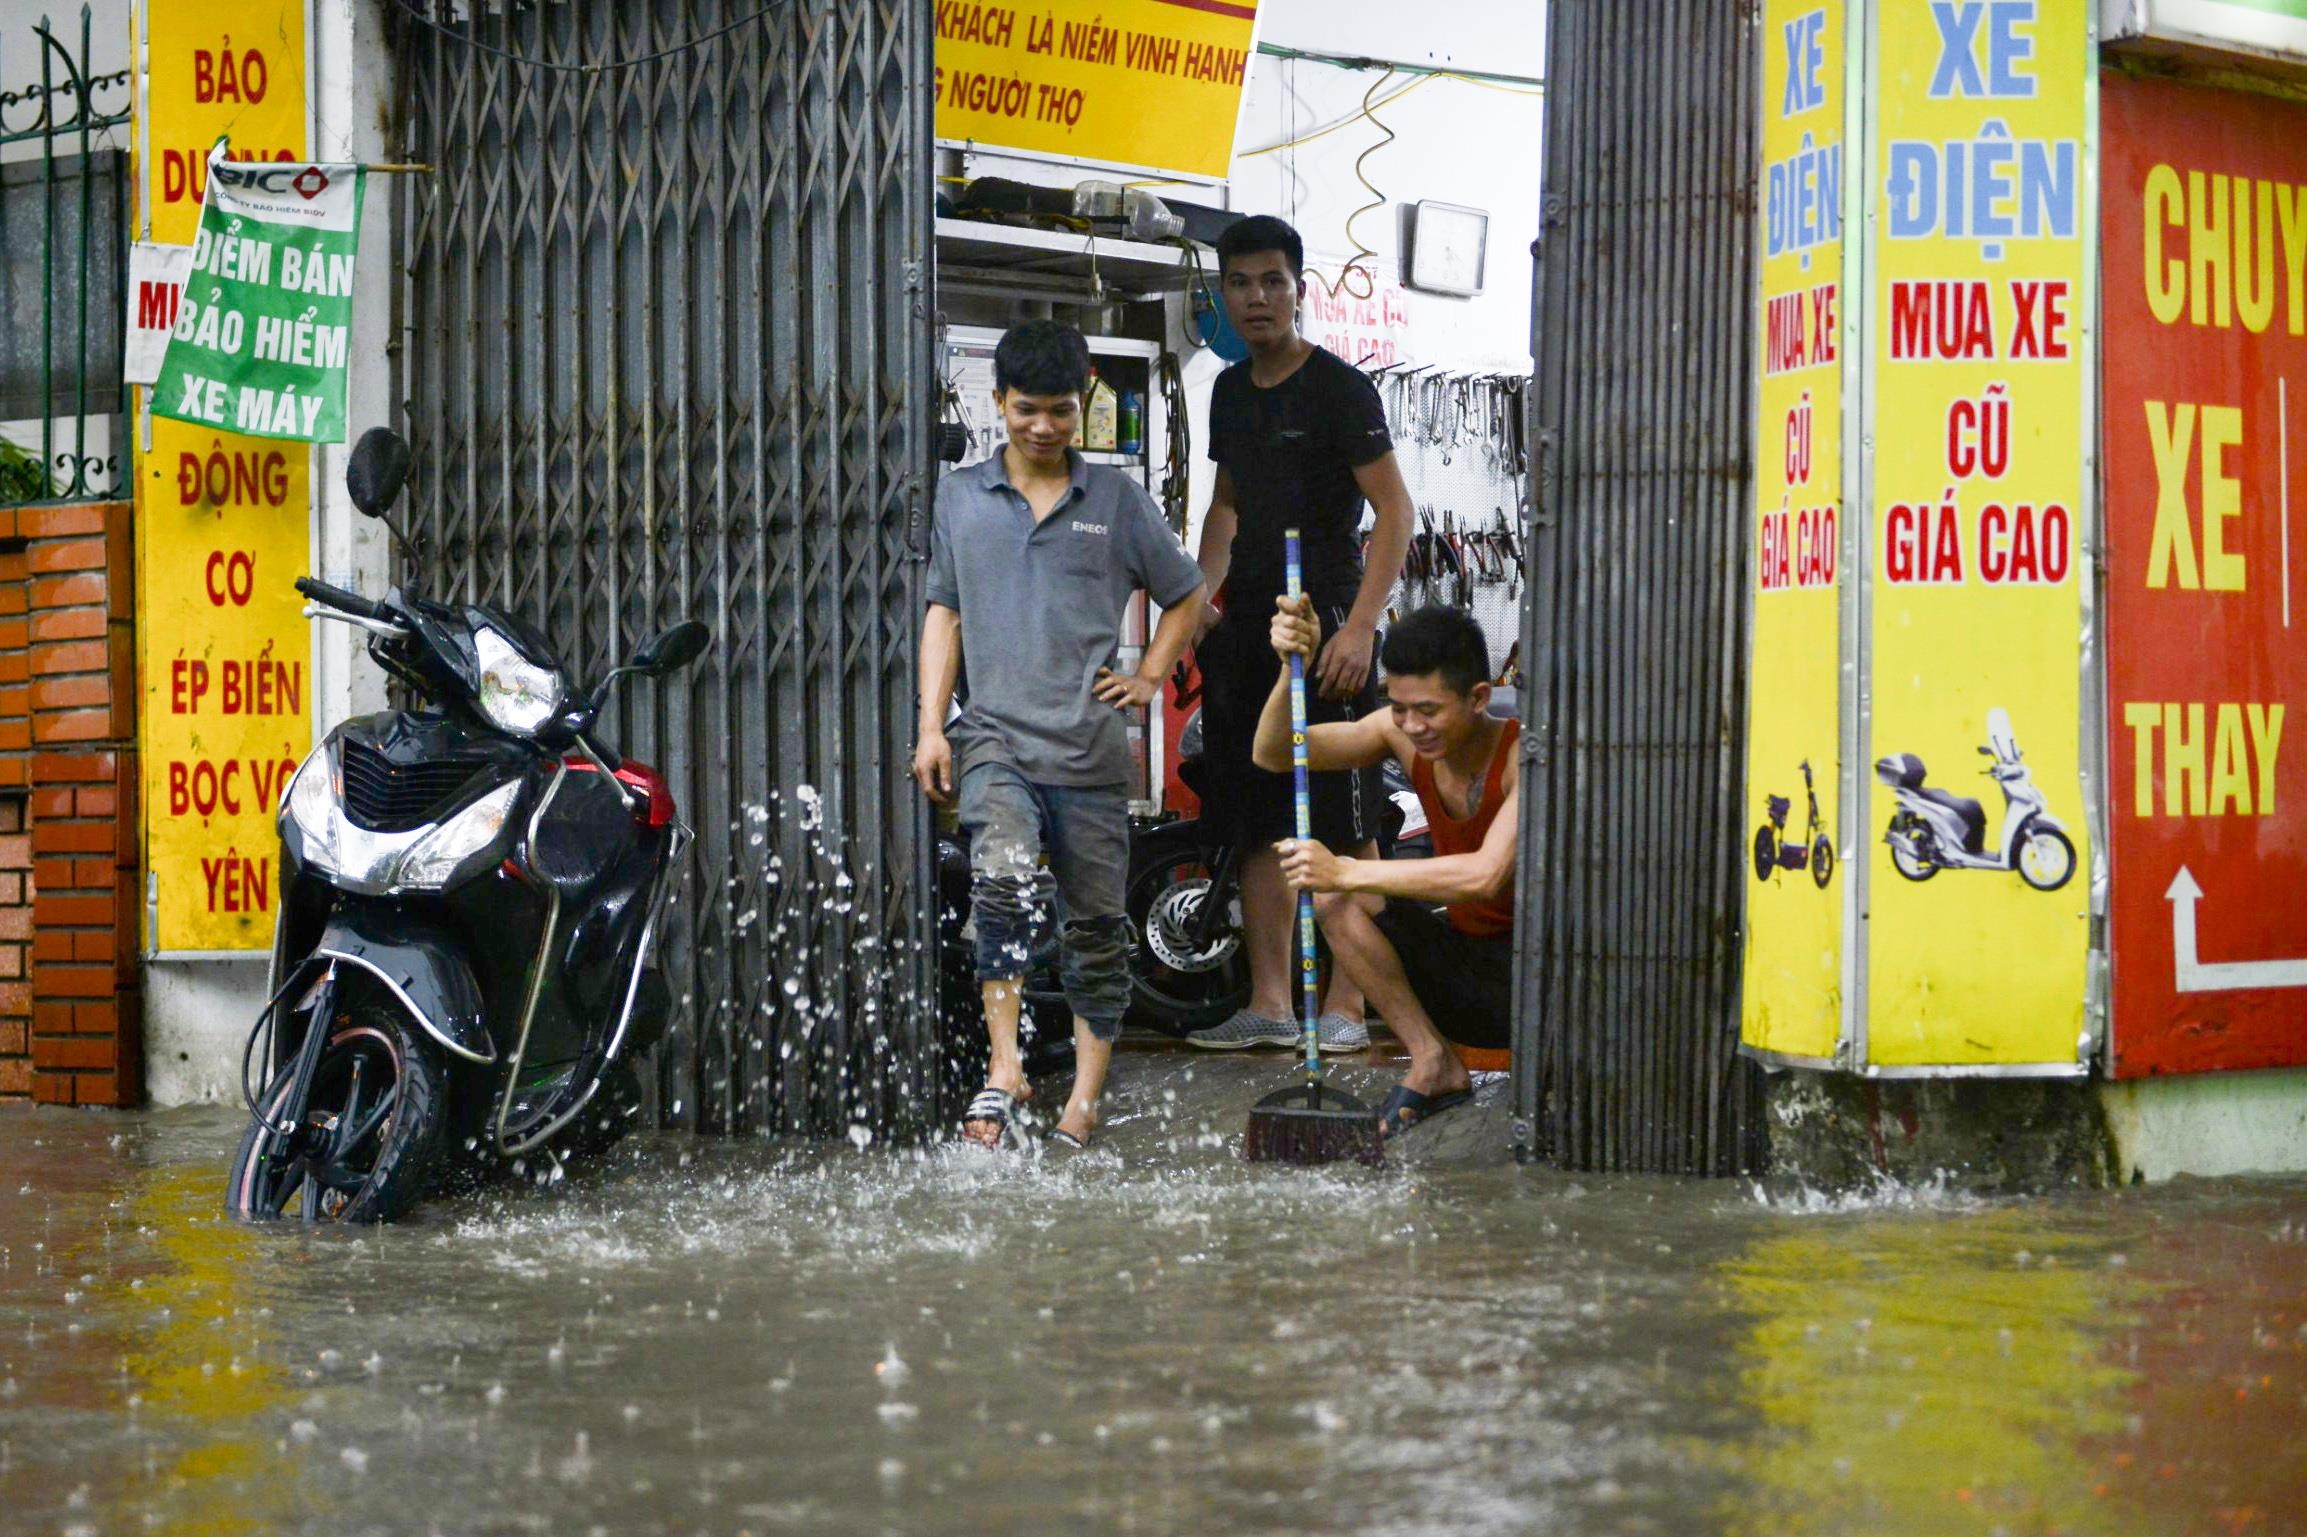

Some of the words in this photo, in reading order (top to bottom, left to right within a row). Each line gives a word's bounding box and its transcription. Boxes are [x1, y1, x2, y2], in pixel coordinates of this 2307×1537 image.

[194, 35, 267, 105] BẢO
[1026, 10, 1053, 56] LÀ
[1126, 32, 1181, 76] VINH
[1183, 42, 1249, 87] HẠNH
[1783, 10, 1825, 117] XE
[1929, 0, 2036, 97] XE
[948, 70, 1032, 118] NGƯỜI
[1037, 84, 1087, 134] THỢ
[1767, 132, 1841, 271] ĐIỆN
[1887, 119, 2076, 260] ĐIỆN
[280, 243, 355, 297] BÁN
[2144, 162, 2307, 336] CHUY
[173, 287, 245, 355] BẢO
[254, 305, 347, 369] HIỂM
[1767, 292, 1805, 374] MUA
[1811, 283, 1836, 365] XE
[1891, 282, 1994, 359] MUA
[2010, 282, 2068, 359] XE
[177, 373, 228, 423] XE
[237, 384, 324, 437] MÁY
[1948, 385, 2009, 479] CŨ
[177, 439, 289, 520] ĐỘNG
[2144, 400, 2246, 592] XE
[1761, 495, 1790, 590] GIÁ
[1797, 507, 1836, 587] CAO
[1886, 489, 1962, 584] GIÁ
[1979, 504, 2070, 584] CAO
[205, 550, 256, 606] CƠ
[171, 648, 210, 715] ÉP
[222, 639, 301, 716] BIỂN
[169, 759, 241, 828] BỌC
[2124, 703, 2285, 818] THAY
[201, 846, 268, 912] YÊN
